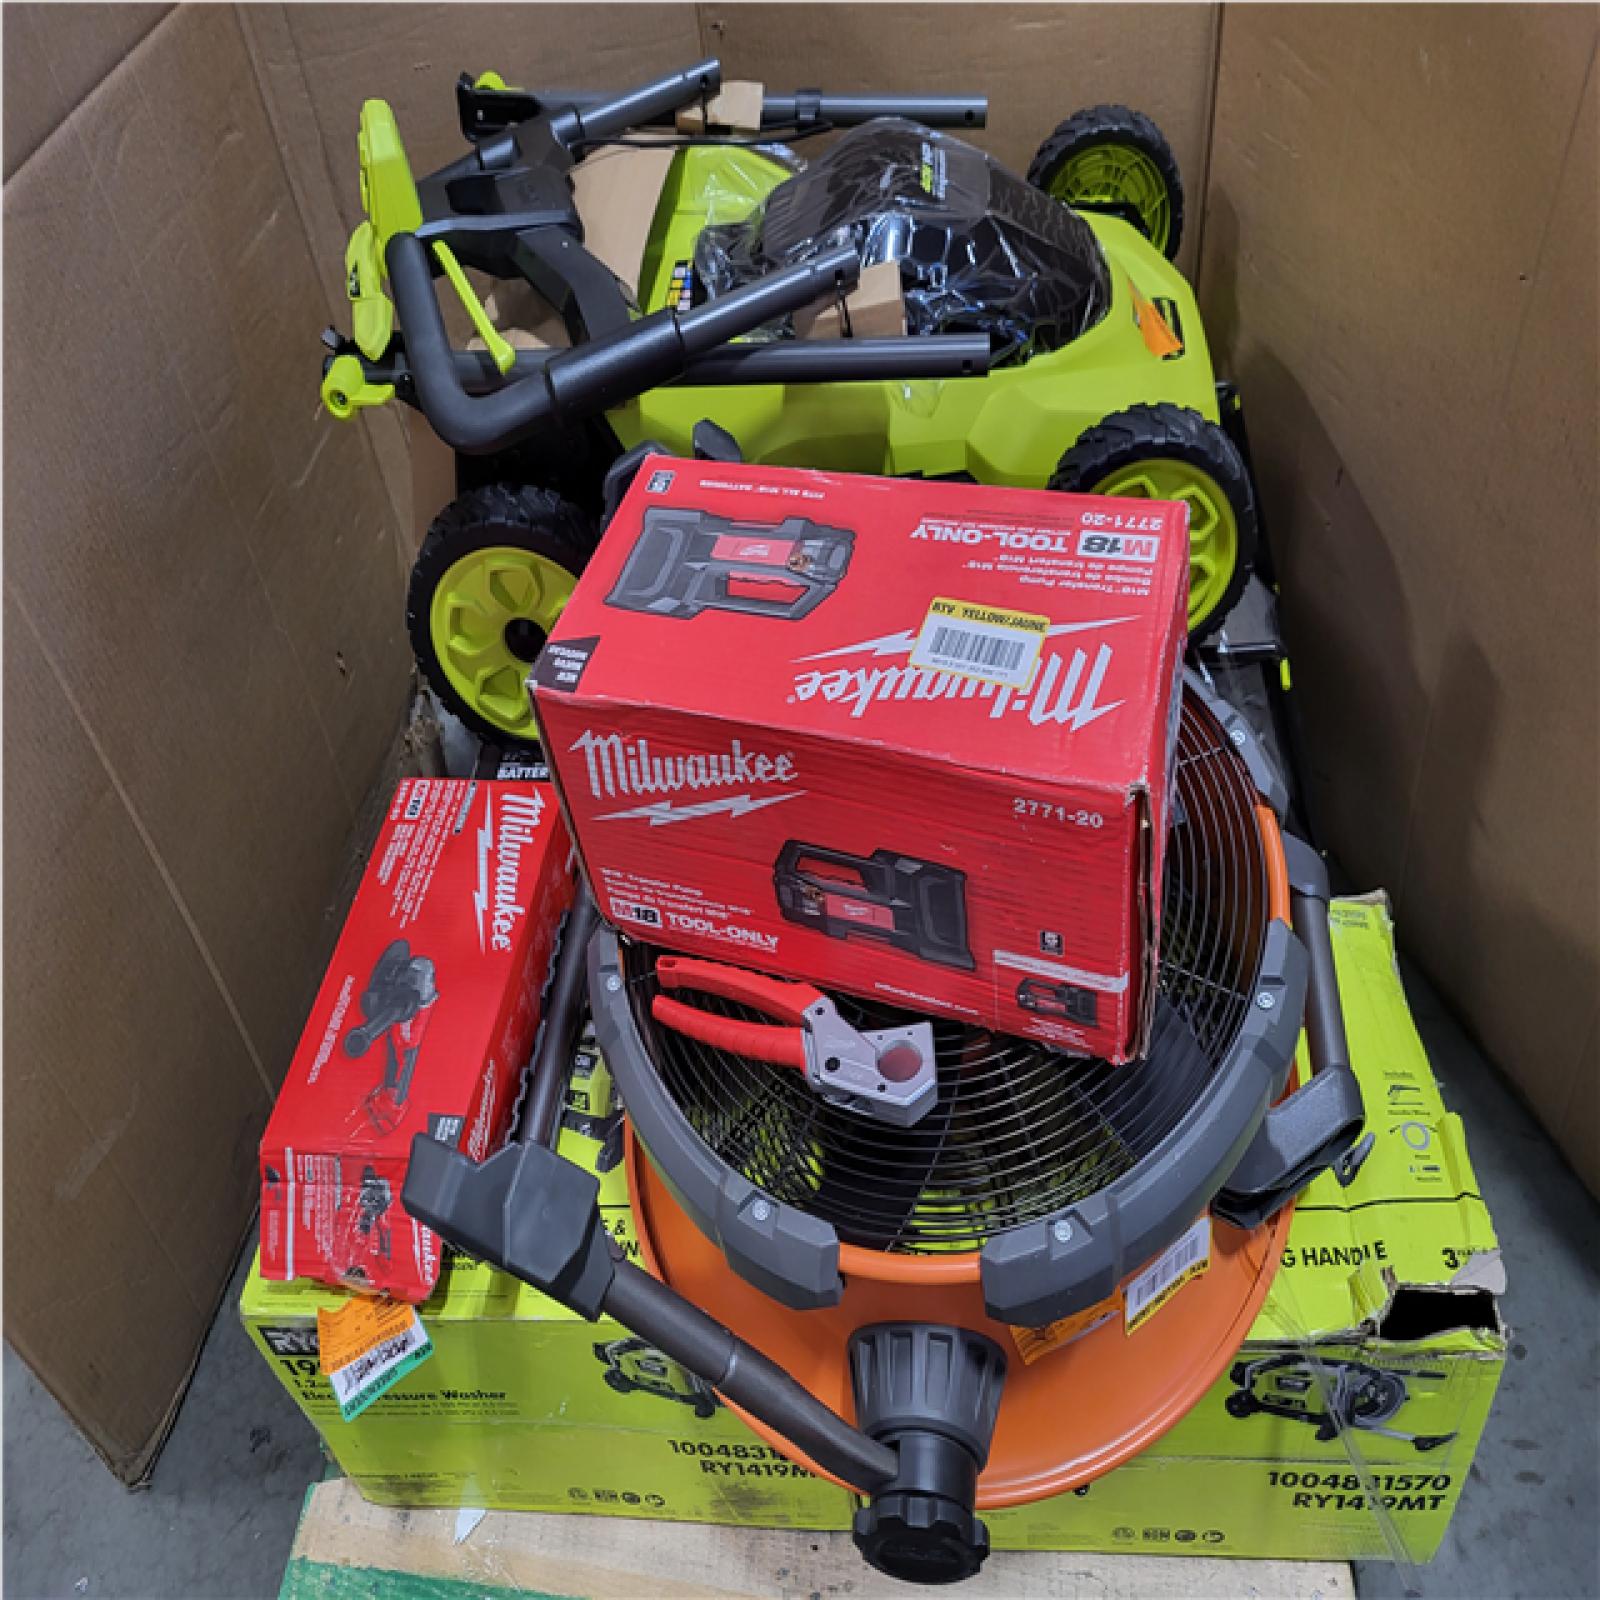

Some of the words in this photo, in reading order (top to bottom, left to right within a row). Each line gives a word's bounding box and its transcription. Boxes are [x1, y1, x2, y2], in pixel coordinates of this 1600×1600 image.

[1081, 513, 1164, 530] 2771-20
[910, 523, 1069, 552] TOOL-ONLY
[1080, 534, 1155, 557] M18
[497, 766, 550, 781] BATTER
[569, 729, 797, 799] Milwaukee
[1012, 797, 1104, 830] 2771-20
[491, 787, 546, 952] Milwaukee
[667, 912, 778, 951] TOOL-ONLY
[440, 1388, 507, 1401] Washer
[700, 1459, 816, 1479] RY1419M
